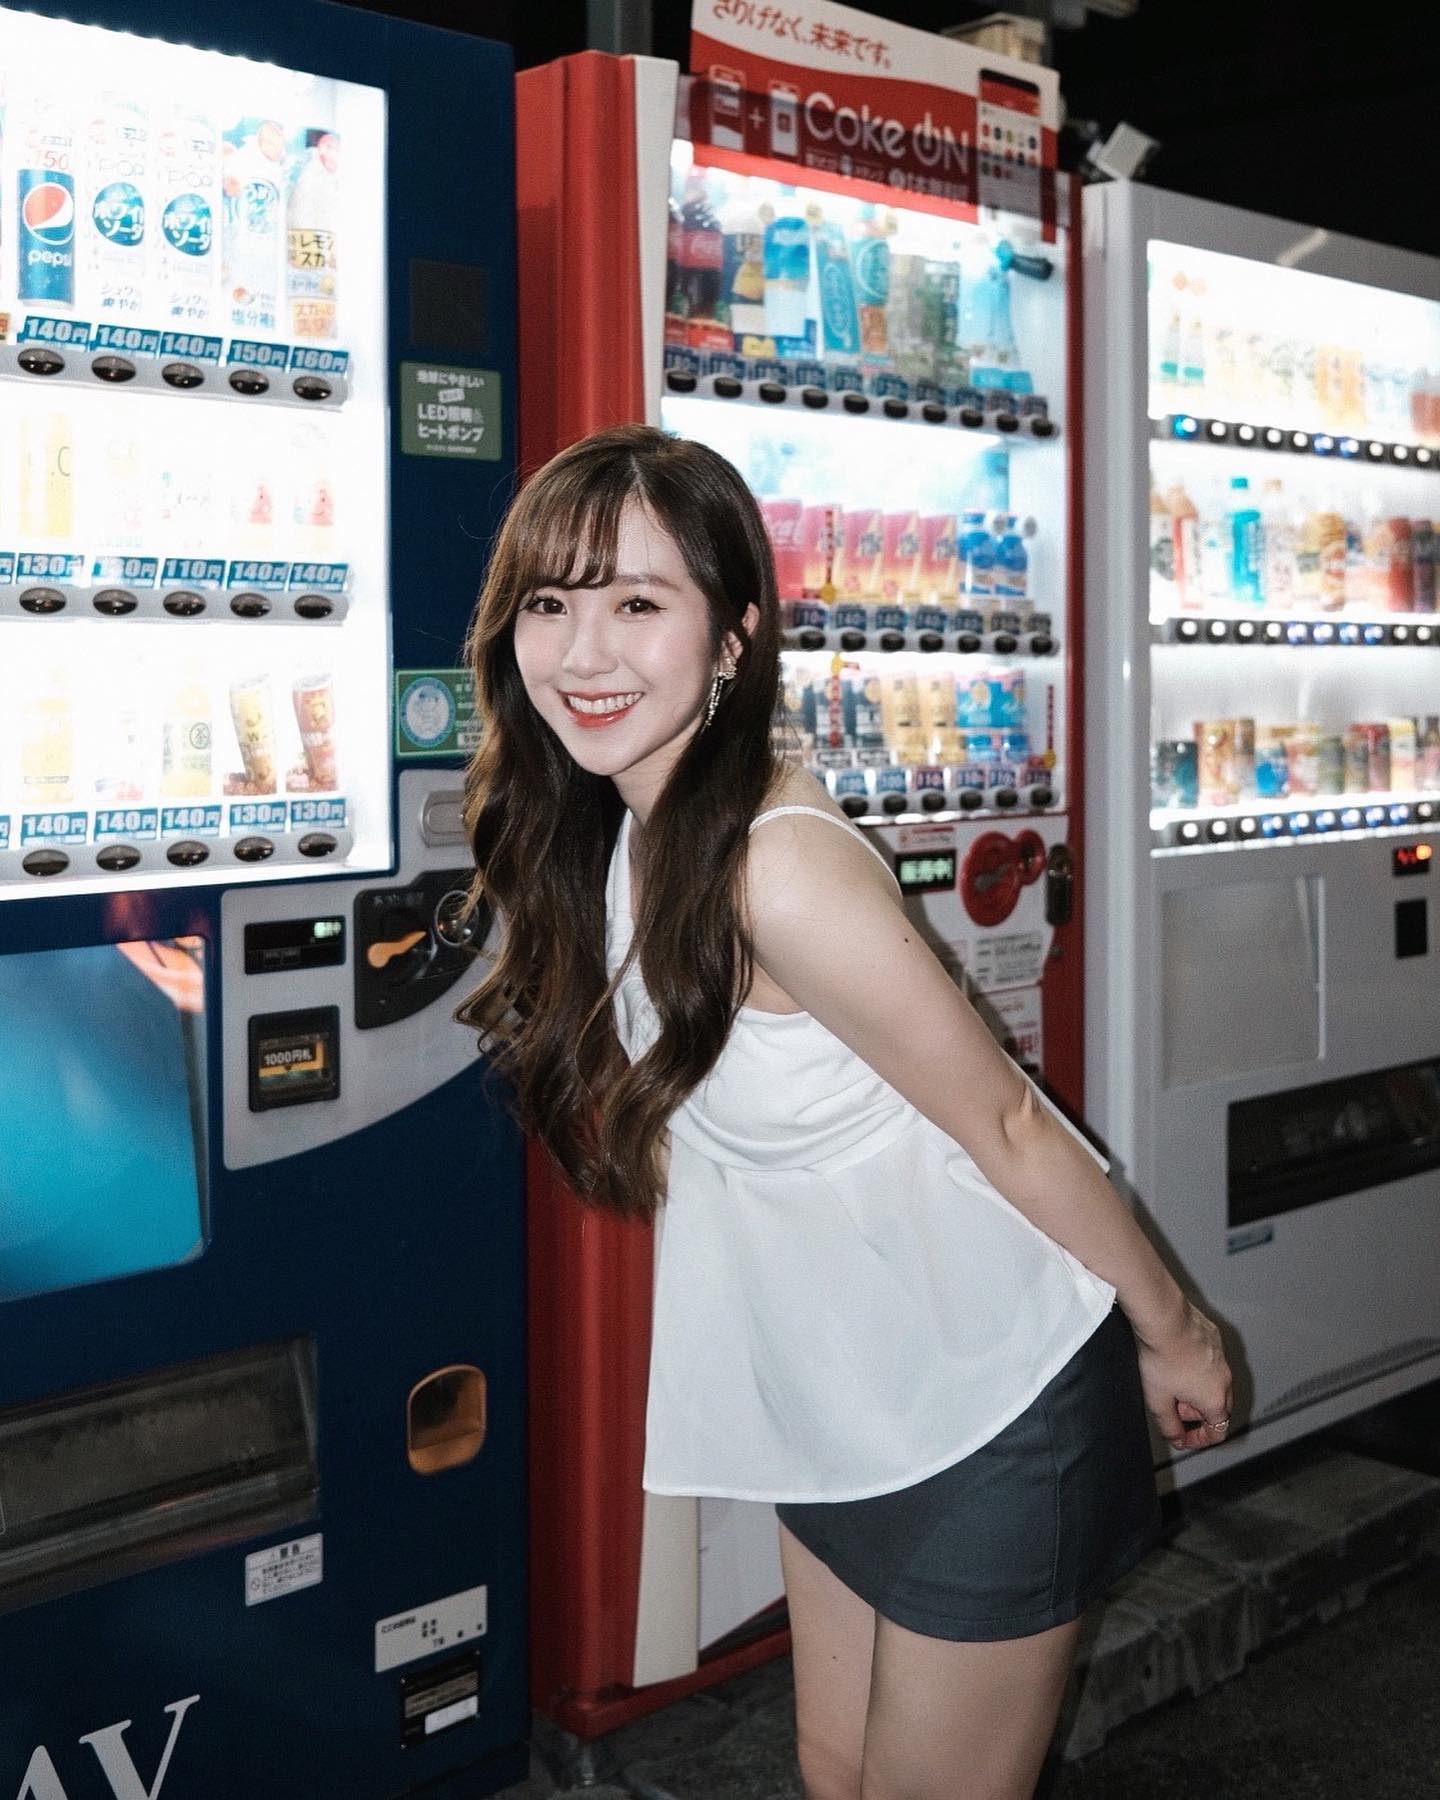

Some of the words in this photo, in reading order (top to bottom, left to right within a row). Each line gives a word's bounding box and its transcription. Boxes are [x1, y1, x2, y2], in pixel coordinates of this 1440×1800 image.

[804, 91, 907, 159] Coke
[912, 111, 969, 176] ON
[26, 318, 89, 344] 140円
[99, 326, 158, 351] 140円
[163, 333, 221, 358] 140円
[232, 341, 287, 366] 150円
[165, 559, 223, 580] 110円
[234, 562, 290, 582] 140円
[295, 564, 346, 584] 140円
[163, 808, 220, 828] 140円
[231, 804, 286, 824] 130円
[292, 801, 345, 820] 130円
[24, 814, 87, 837] 140円
[97, 811, 157, 833] 140円
